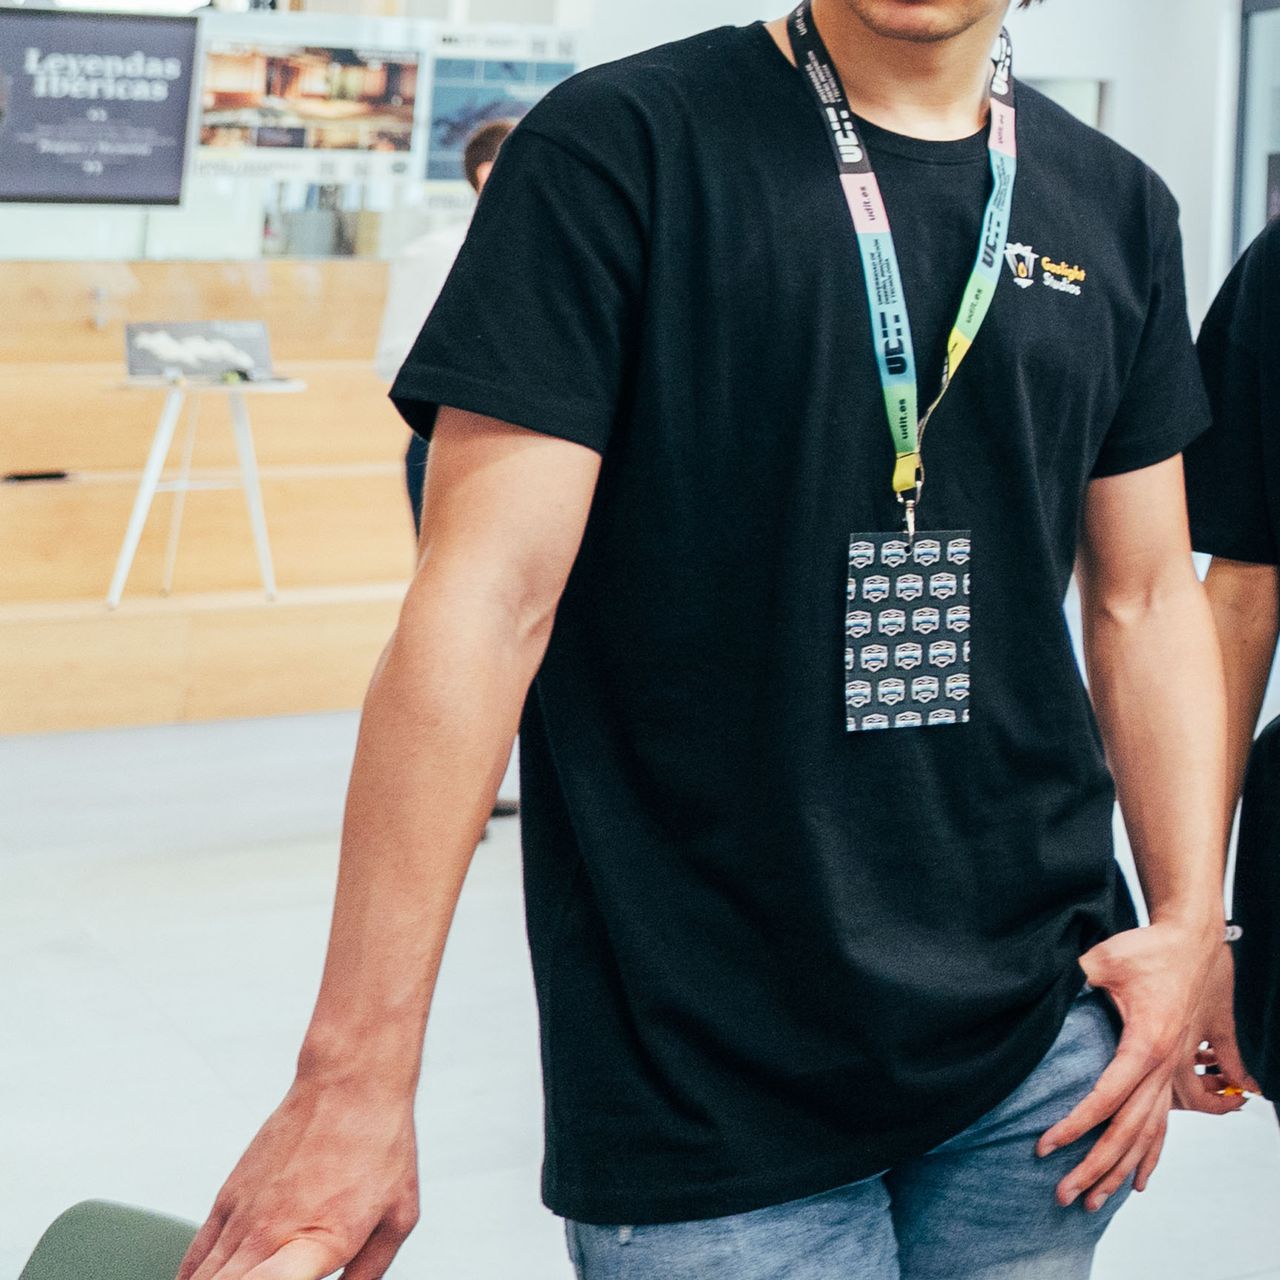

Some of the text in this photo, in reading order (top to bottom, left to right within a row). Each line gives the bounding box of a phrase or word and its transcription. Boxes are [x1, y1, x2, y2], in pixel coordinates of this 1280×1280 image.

[25, 47, 181, 80] Leyendas
[858, 185, 875, 221] udit.es
[895, 398, 910, 439] udit.es
